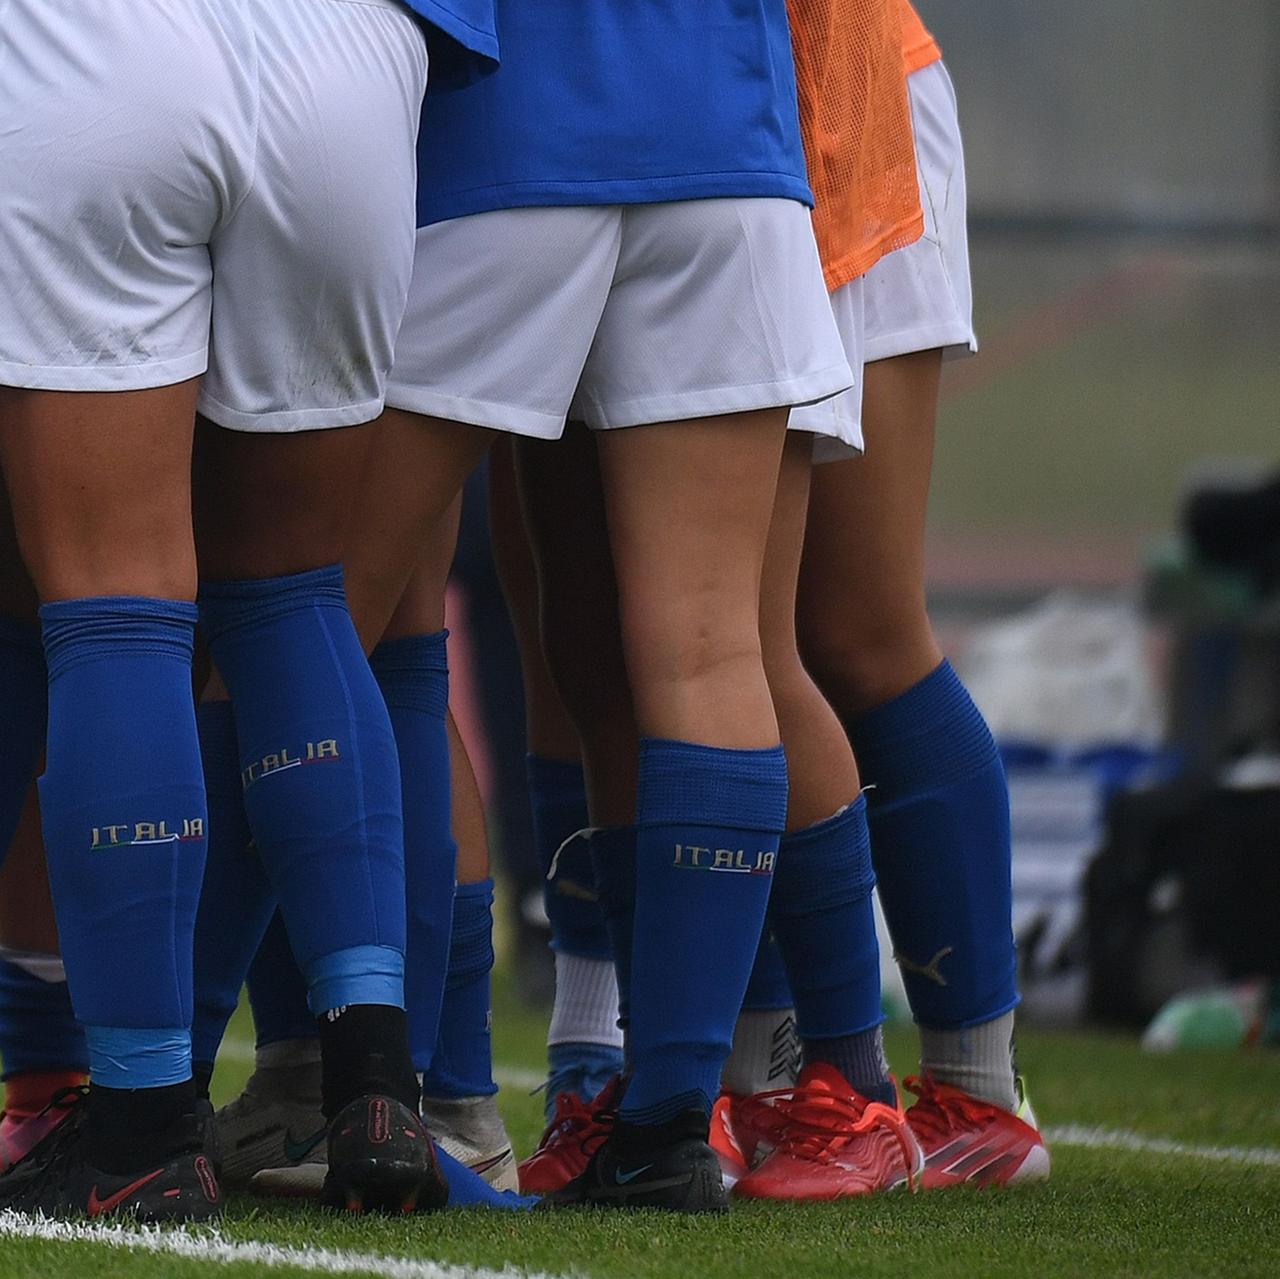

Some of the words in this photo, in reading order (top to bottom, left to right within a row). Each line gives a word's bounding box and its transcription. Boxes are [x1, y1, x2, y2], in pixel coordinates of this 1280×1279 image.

[241, 738, 339, 789] ITALIA
[91, 818, 203, 849] ITALIA
[675, 844, 775, 872] ITALIA
